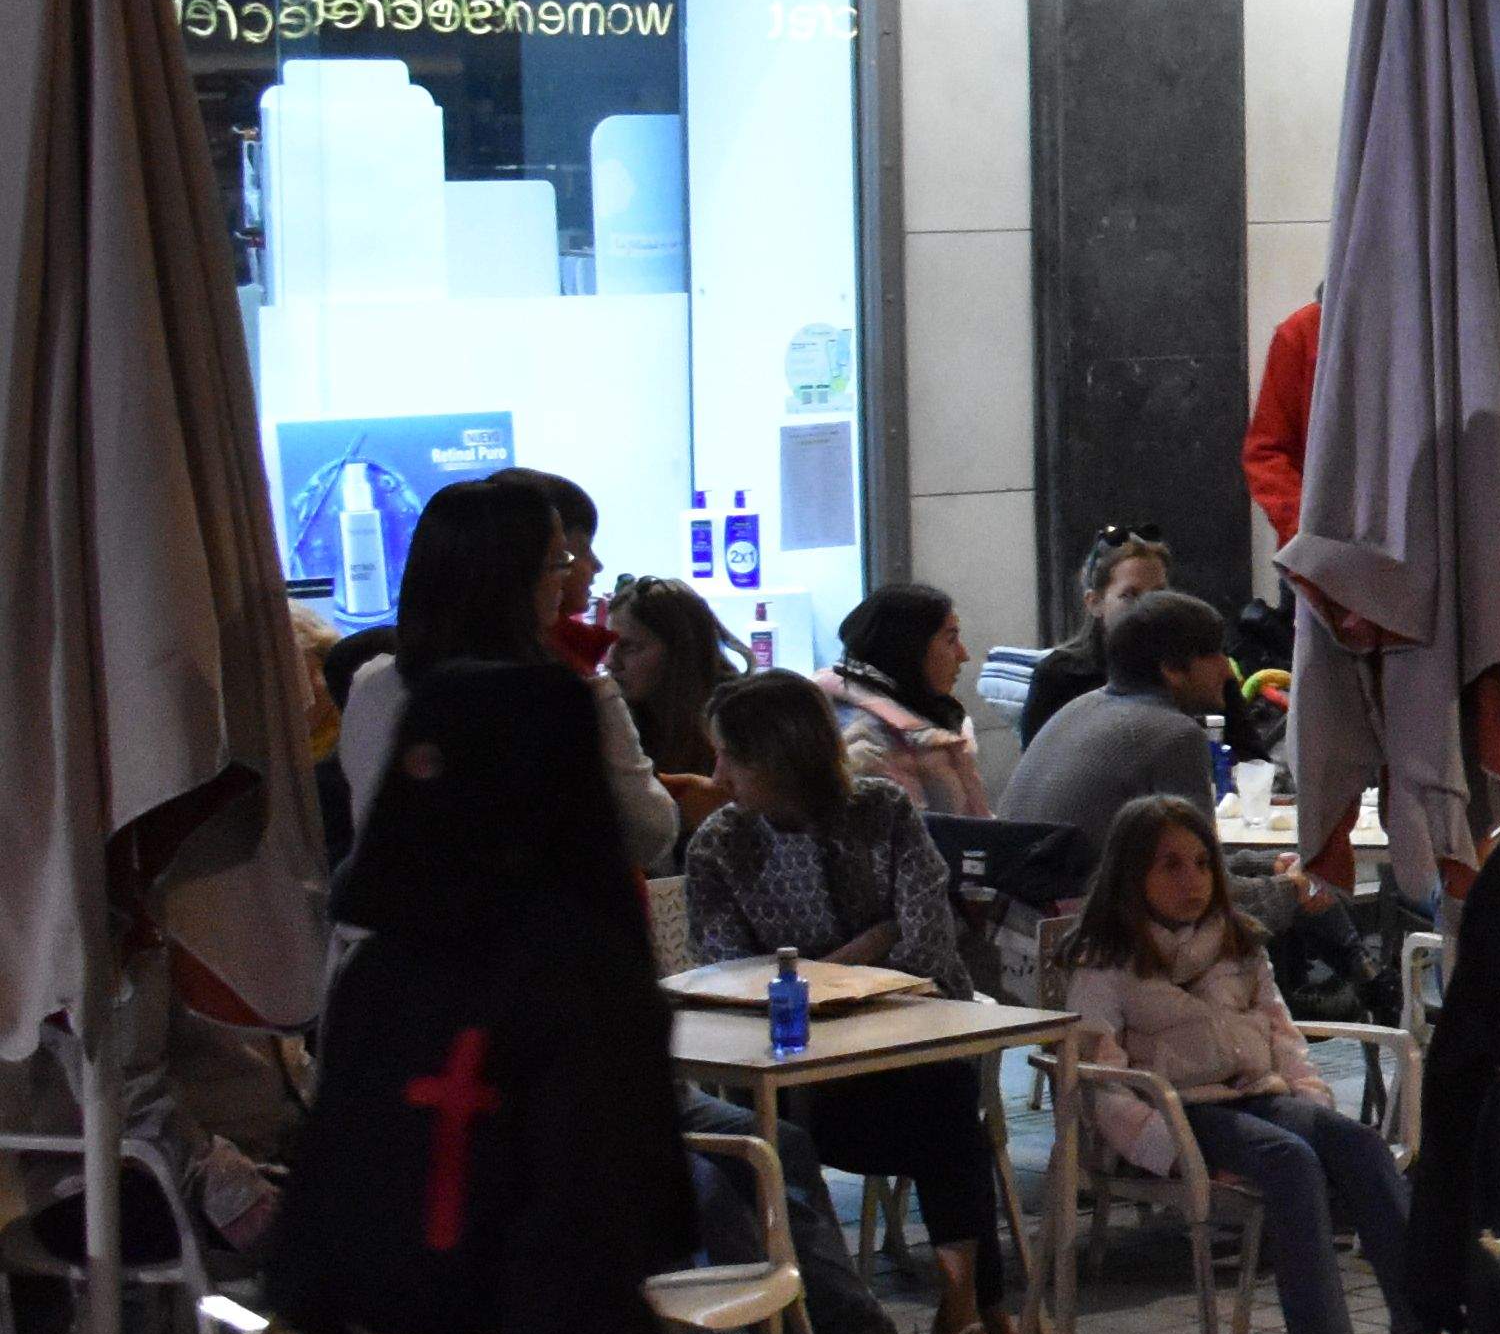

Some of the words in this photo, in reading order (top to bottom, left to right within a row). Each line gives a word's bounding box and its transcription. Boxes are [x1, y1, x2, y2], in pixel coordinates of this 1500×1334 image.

[432, 447, 476, 463] Retinol
[478, 445, 508, 461] Puro
[730, 550, 755, 565] 2x1
